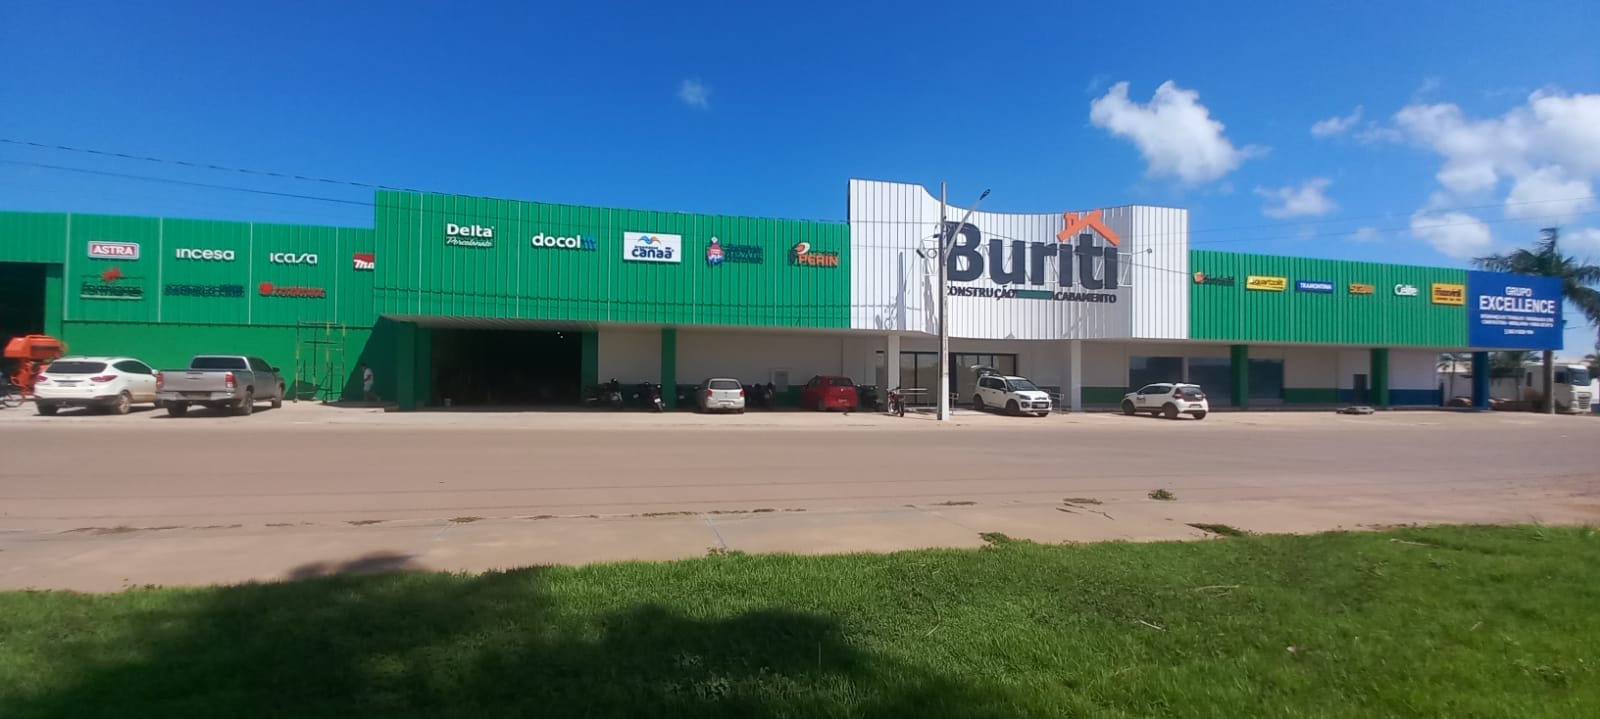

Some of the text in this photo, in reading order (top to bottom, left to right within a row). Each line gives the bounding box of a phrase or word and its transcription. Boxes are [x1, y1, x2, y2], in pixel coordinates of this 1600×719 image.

[446, 223, 493, 238] Delta
[532, 232, 581, 249] docol
[93, 245, 133, 255] ASTRA
[176, 248, 234, 260] incesa
[945, 221, 1118, 289] Buriti
[1505, 286, 1533, 297] GRUPO
[1479, 295, 1555, 314] EXCELLENCE
